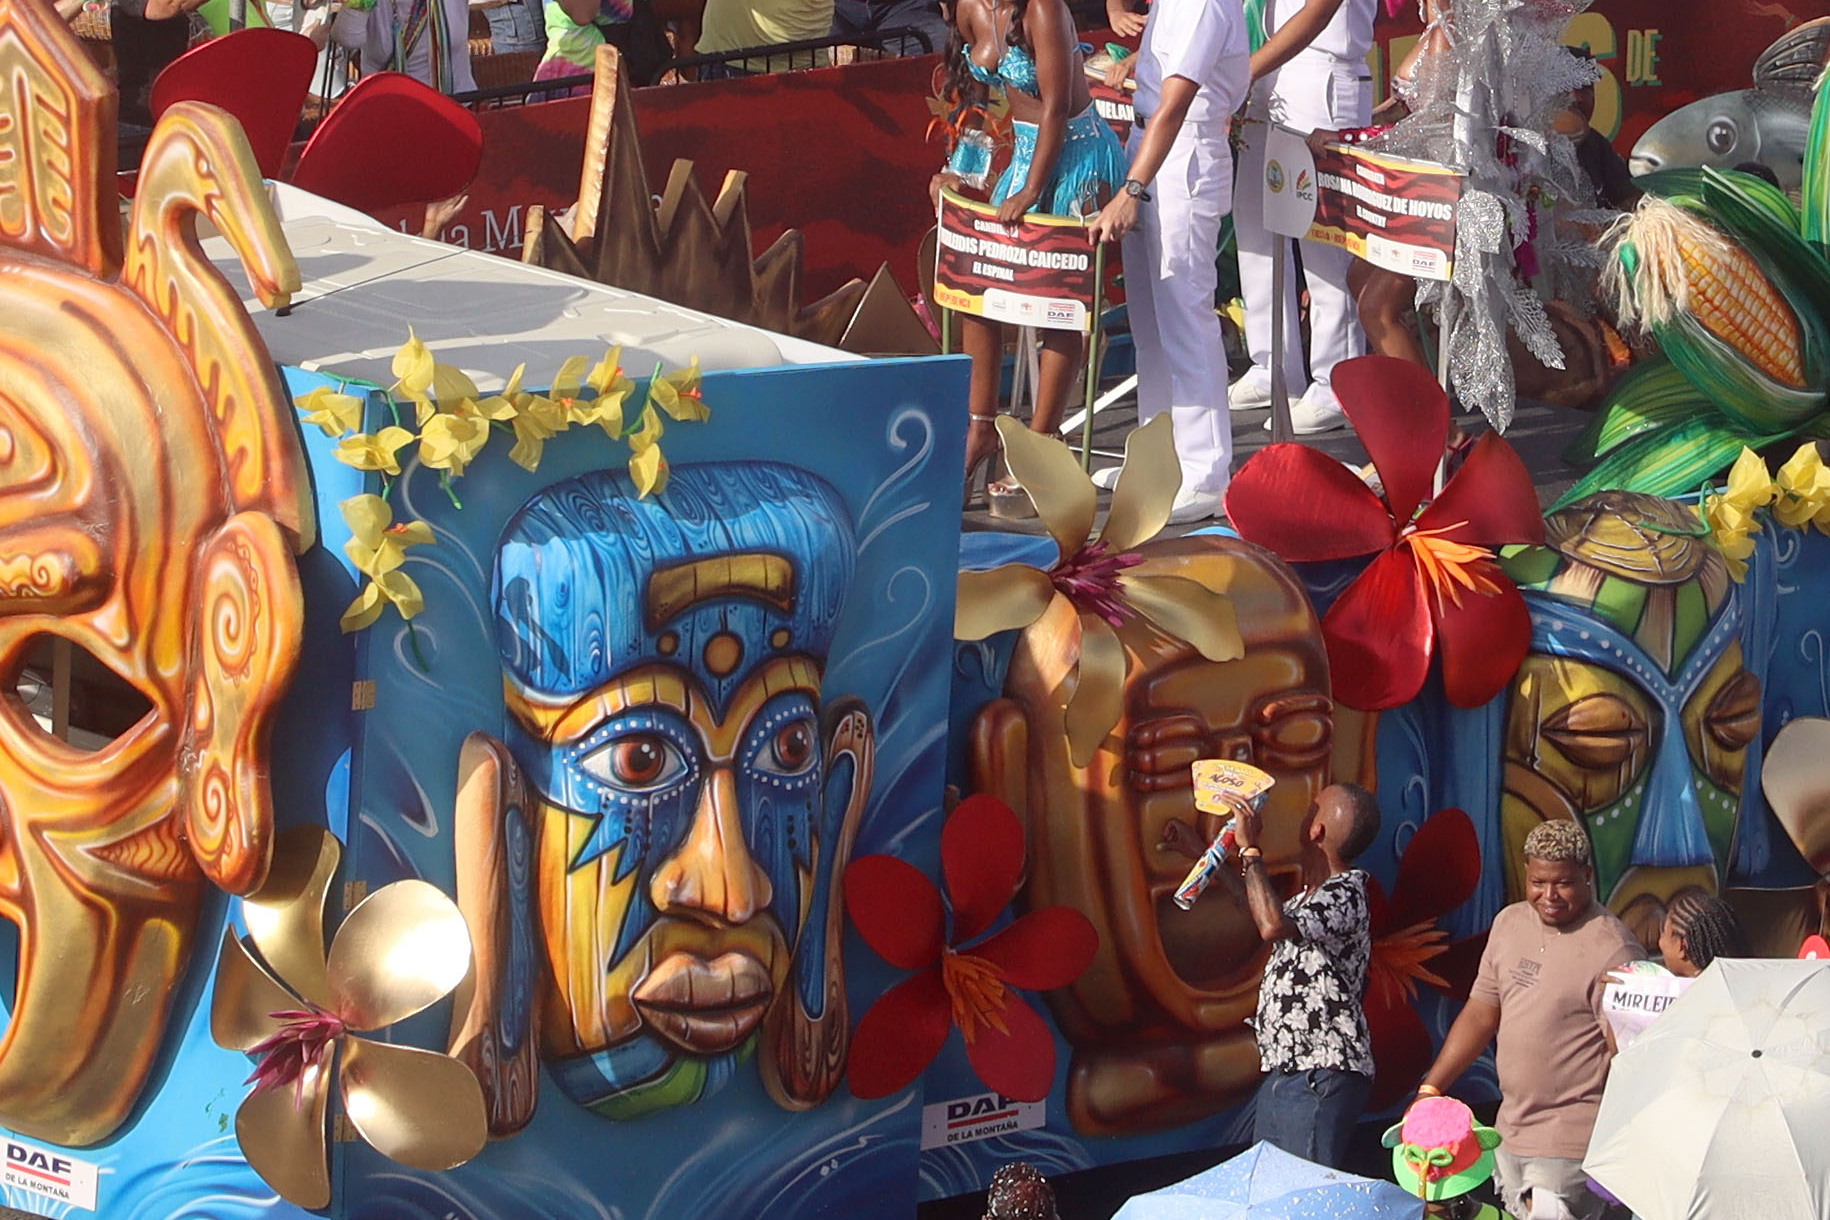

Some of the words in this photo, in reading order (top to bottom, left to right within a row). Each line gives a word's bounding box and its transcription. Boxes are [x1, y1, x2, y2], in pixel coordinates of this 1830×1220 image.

[1625, 28, 1673, 87] DE
[1393, 196, 1409, 216] DE
[1408, 199, 1454, 221] HOYOS
[978, 238, 1028, 266] PEDROZA
[1028, 250, 1088, 271] CAICEDO
[972, 261, 982, 274] EL
[982, 263, 1014, 282] ESPINAL
[947, 1134, 959, 1142] DE
[961, 1131, 973, 1140] LA
[975, 1121, 1018, 1137] MONTAÑA
[7, 1143, 72, 1174] DAF
[5, 1172, 16, 1182] DE
[18, 1176, 28, 1186] LA
[30, 1179, 70, 1199] MONTAÑA
